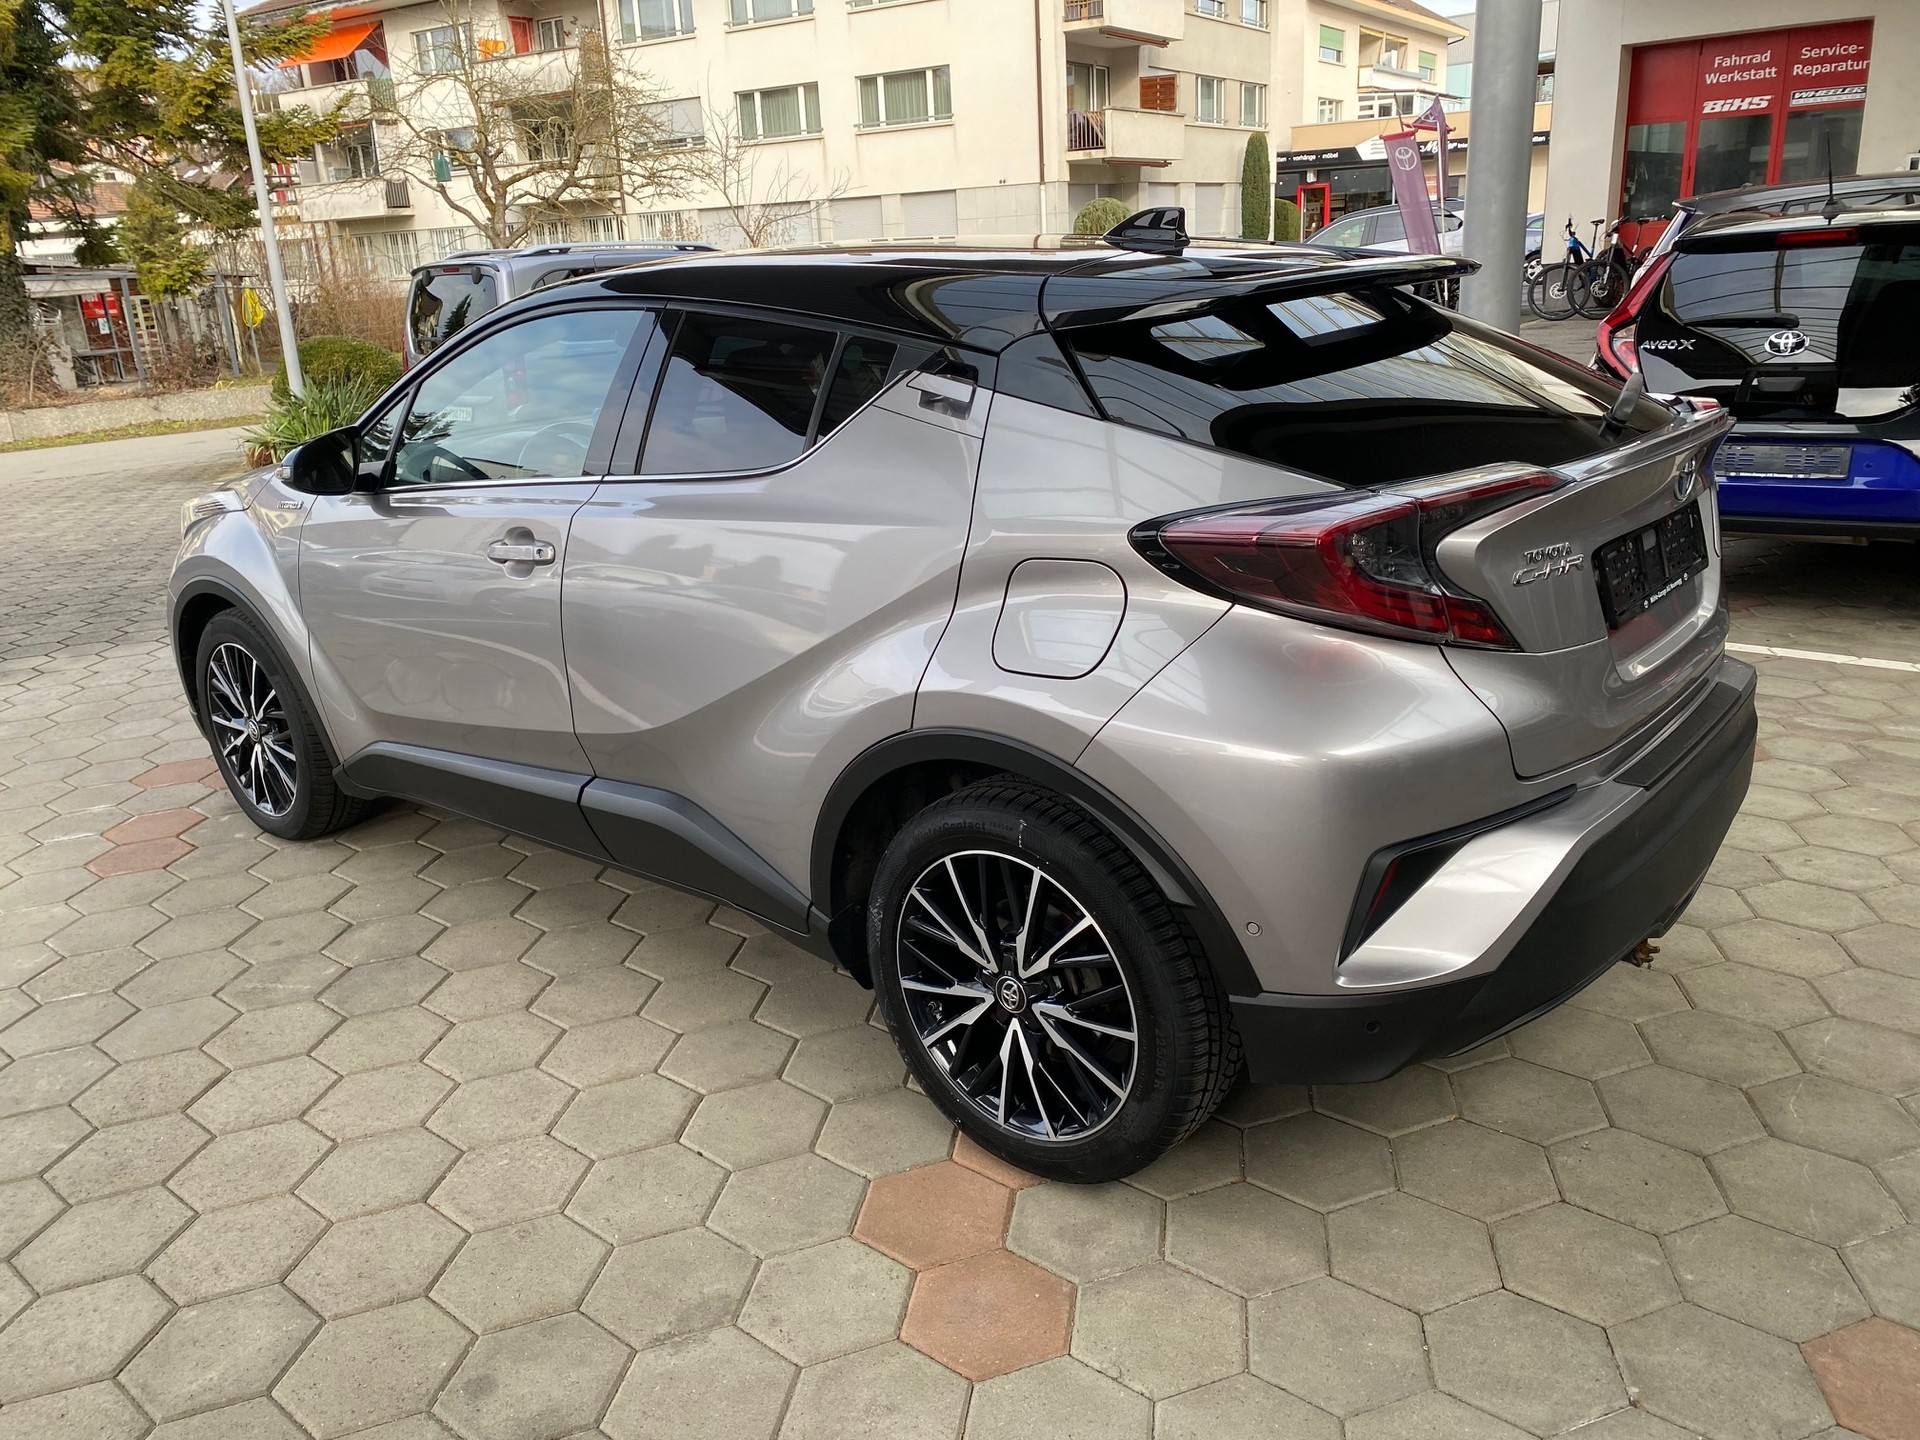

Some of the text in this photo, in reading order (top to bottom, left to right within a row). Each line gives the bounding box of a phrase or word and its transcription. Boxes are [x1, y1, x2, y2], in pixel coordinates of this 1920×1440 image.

[1714, 50, 1771, 68] Fahrrad
[1801, 43, 1864, 59] Service-
[1705, 66, 1778, 84] Werkstatt
[1793, 59, 1870, 76] Reparatur
[1794, 86, 1866, 99] WHEELER
[1523, 542, 1572, 565] TOYOTA
[1512, 554, 1584, 587] C-HR
